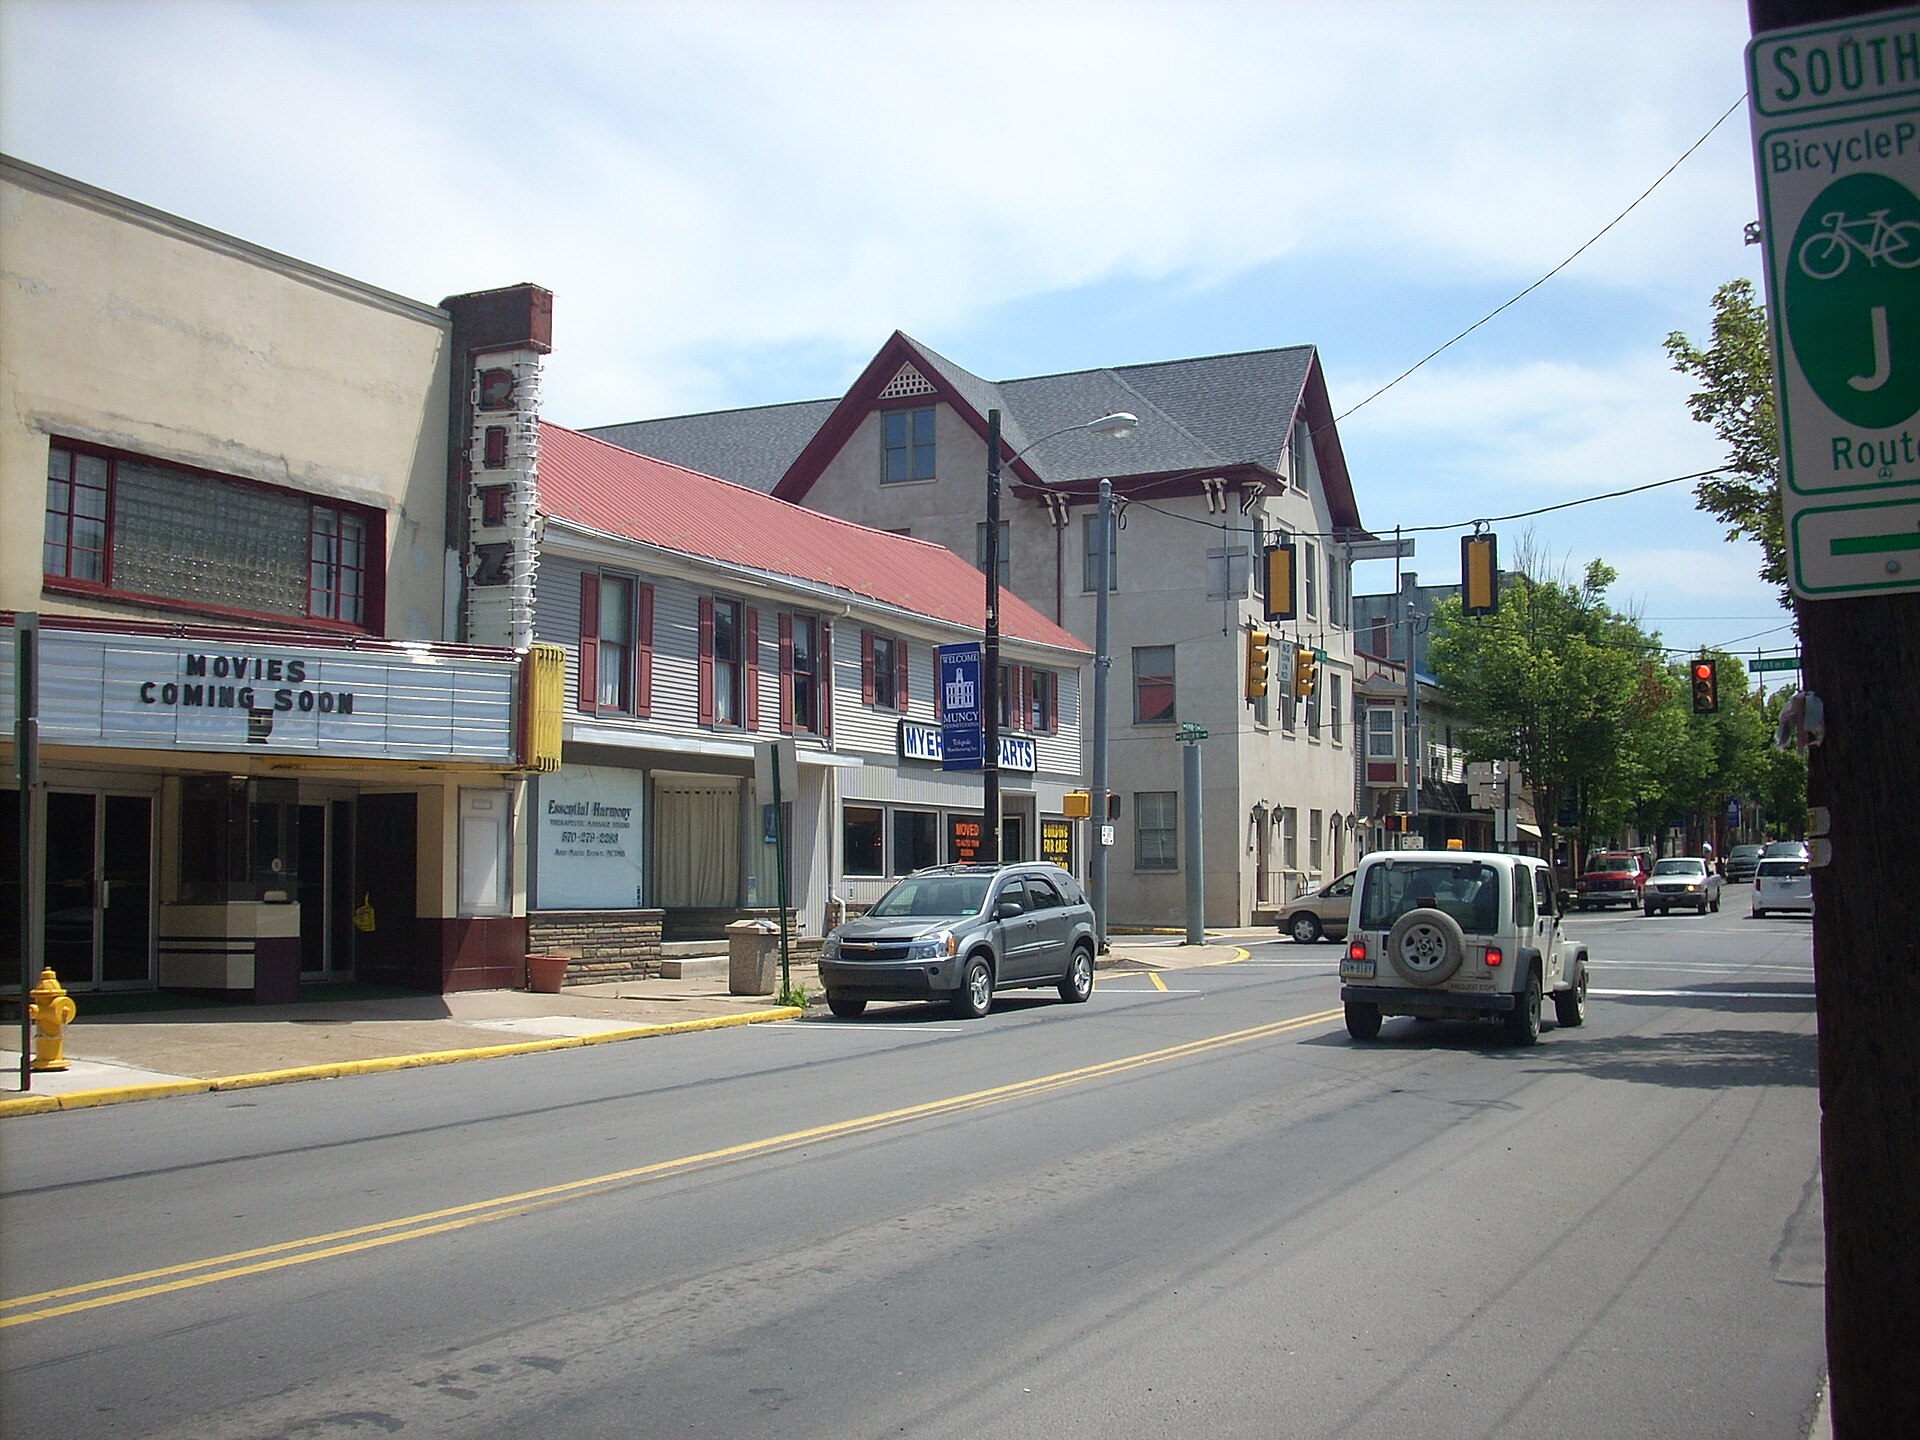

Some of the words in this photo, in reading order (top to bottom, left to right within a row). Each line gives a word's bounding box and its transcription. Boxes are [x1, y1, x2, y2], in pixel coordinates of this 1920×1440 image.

[1773, 33, 1920, 102] SOUTH
[1770, 122, 1920, 174] BicycleP
[1847, 306, 1891, 392] J
[1831, 431, 1920, 471] Rout
[473, 368, 517, 587] RITZ
[187, 654, 306, 683] MOVIES
[942, 653, 979, 664] WELCOME
[1752, 660, 1786, 670] Water
[141, 682, 255, 709] COMING
[274, 689, 353, 714] SOON
[943, 711, 979, 723] MUNCY
[905, 727, 943, 757] MYER
[548, 799, 589, 817] Essential
[593, 802, 632, 821] Harmony
[955, 823, 979, 836] MOVED
[1043, 824, 1069, 839] BUILDING
[1043, 839, 1055, 853] FOR
[1055, 839, 1069, 854] SALE
[1353, 935, 1371, 943] MAIL
